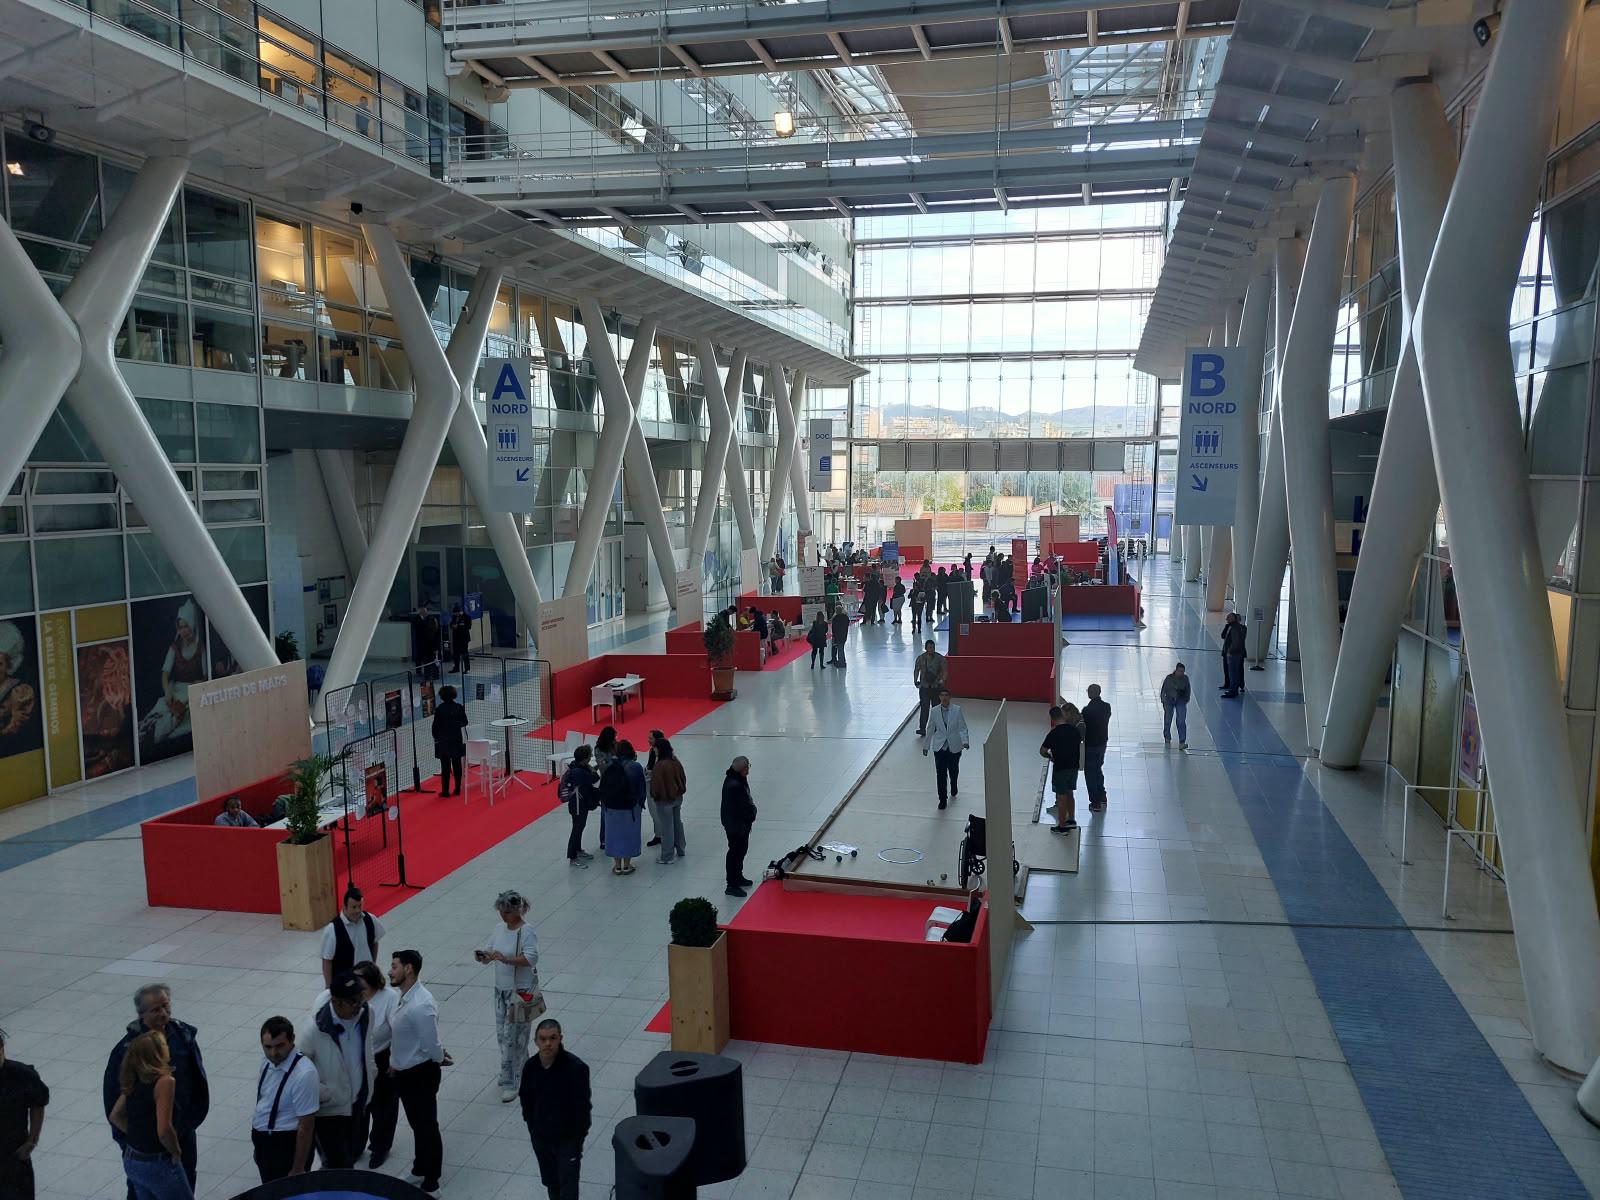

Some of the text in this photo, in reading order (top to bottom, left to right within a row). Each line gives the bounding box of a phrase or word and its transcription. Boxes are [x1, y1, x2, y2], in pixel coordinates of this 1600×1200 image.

[492, 363, 527, 400] A
[1190, 353, 1226, 397] B
[492, 403, 529, 414] NORD
[1188, 402, 1237, 415] NORD
[1189, 462, 1239, 470] ASCENSEURS
[44, 620, 53, 634] LA
[46, 636, 56, 664] BELLE
[200, 686, 241, 706] ATELIER
